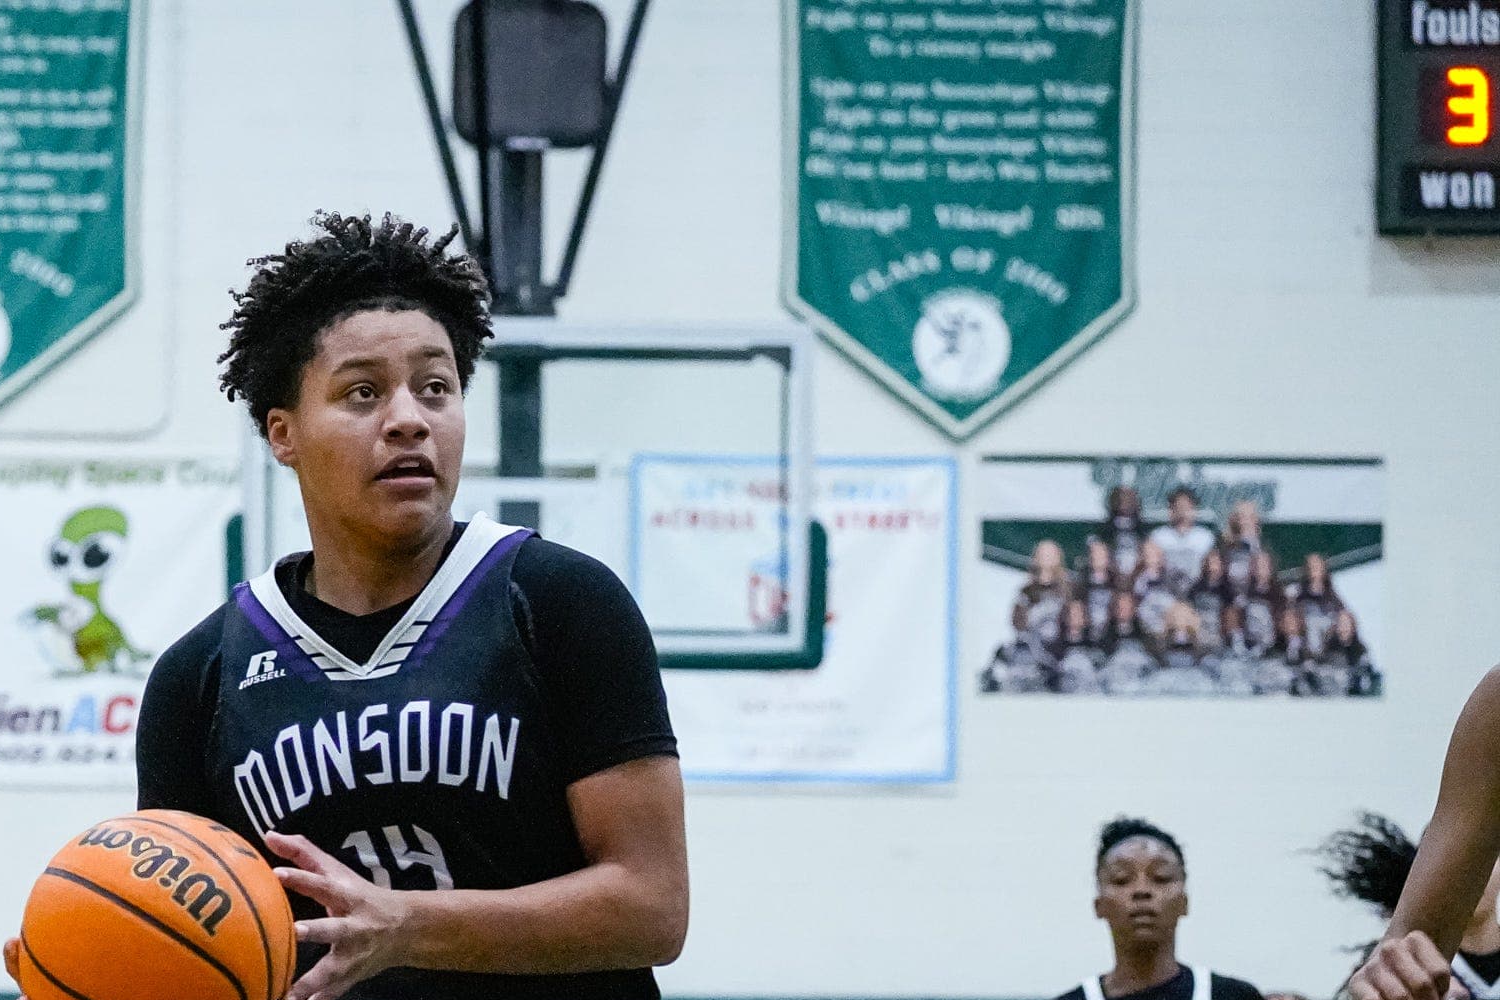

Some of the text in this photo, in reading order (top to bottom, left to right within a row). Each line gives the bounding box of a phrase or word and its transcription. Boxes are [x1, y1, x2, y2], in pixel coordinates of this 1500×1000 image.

[1411, 0, 1500, 45] fouls
[1446, 66, 1490, 145] 3
[1420, 170, 1495, 208] won
[239, 668, 287, 690] RUSSELL
[234, 700, 519, 841] MONSOON
[79, 826, 232, 937] Wilson
[340, 824, 454, 890] 14
